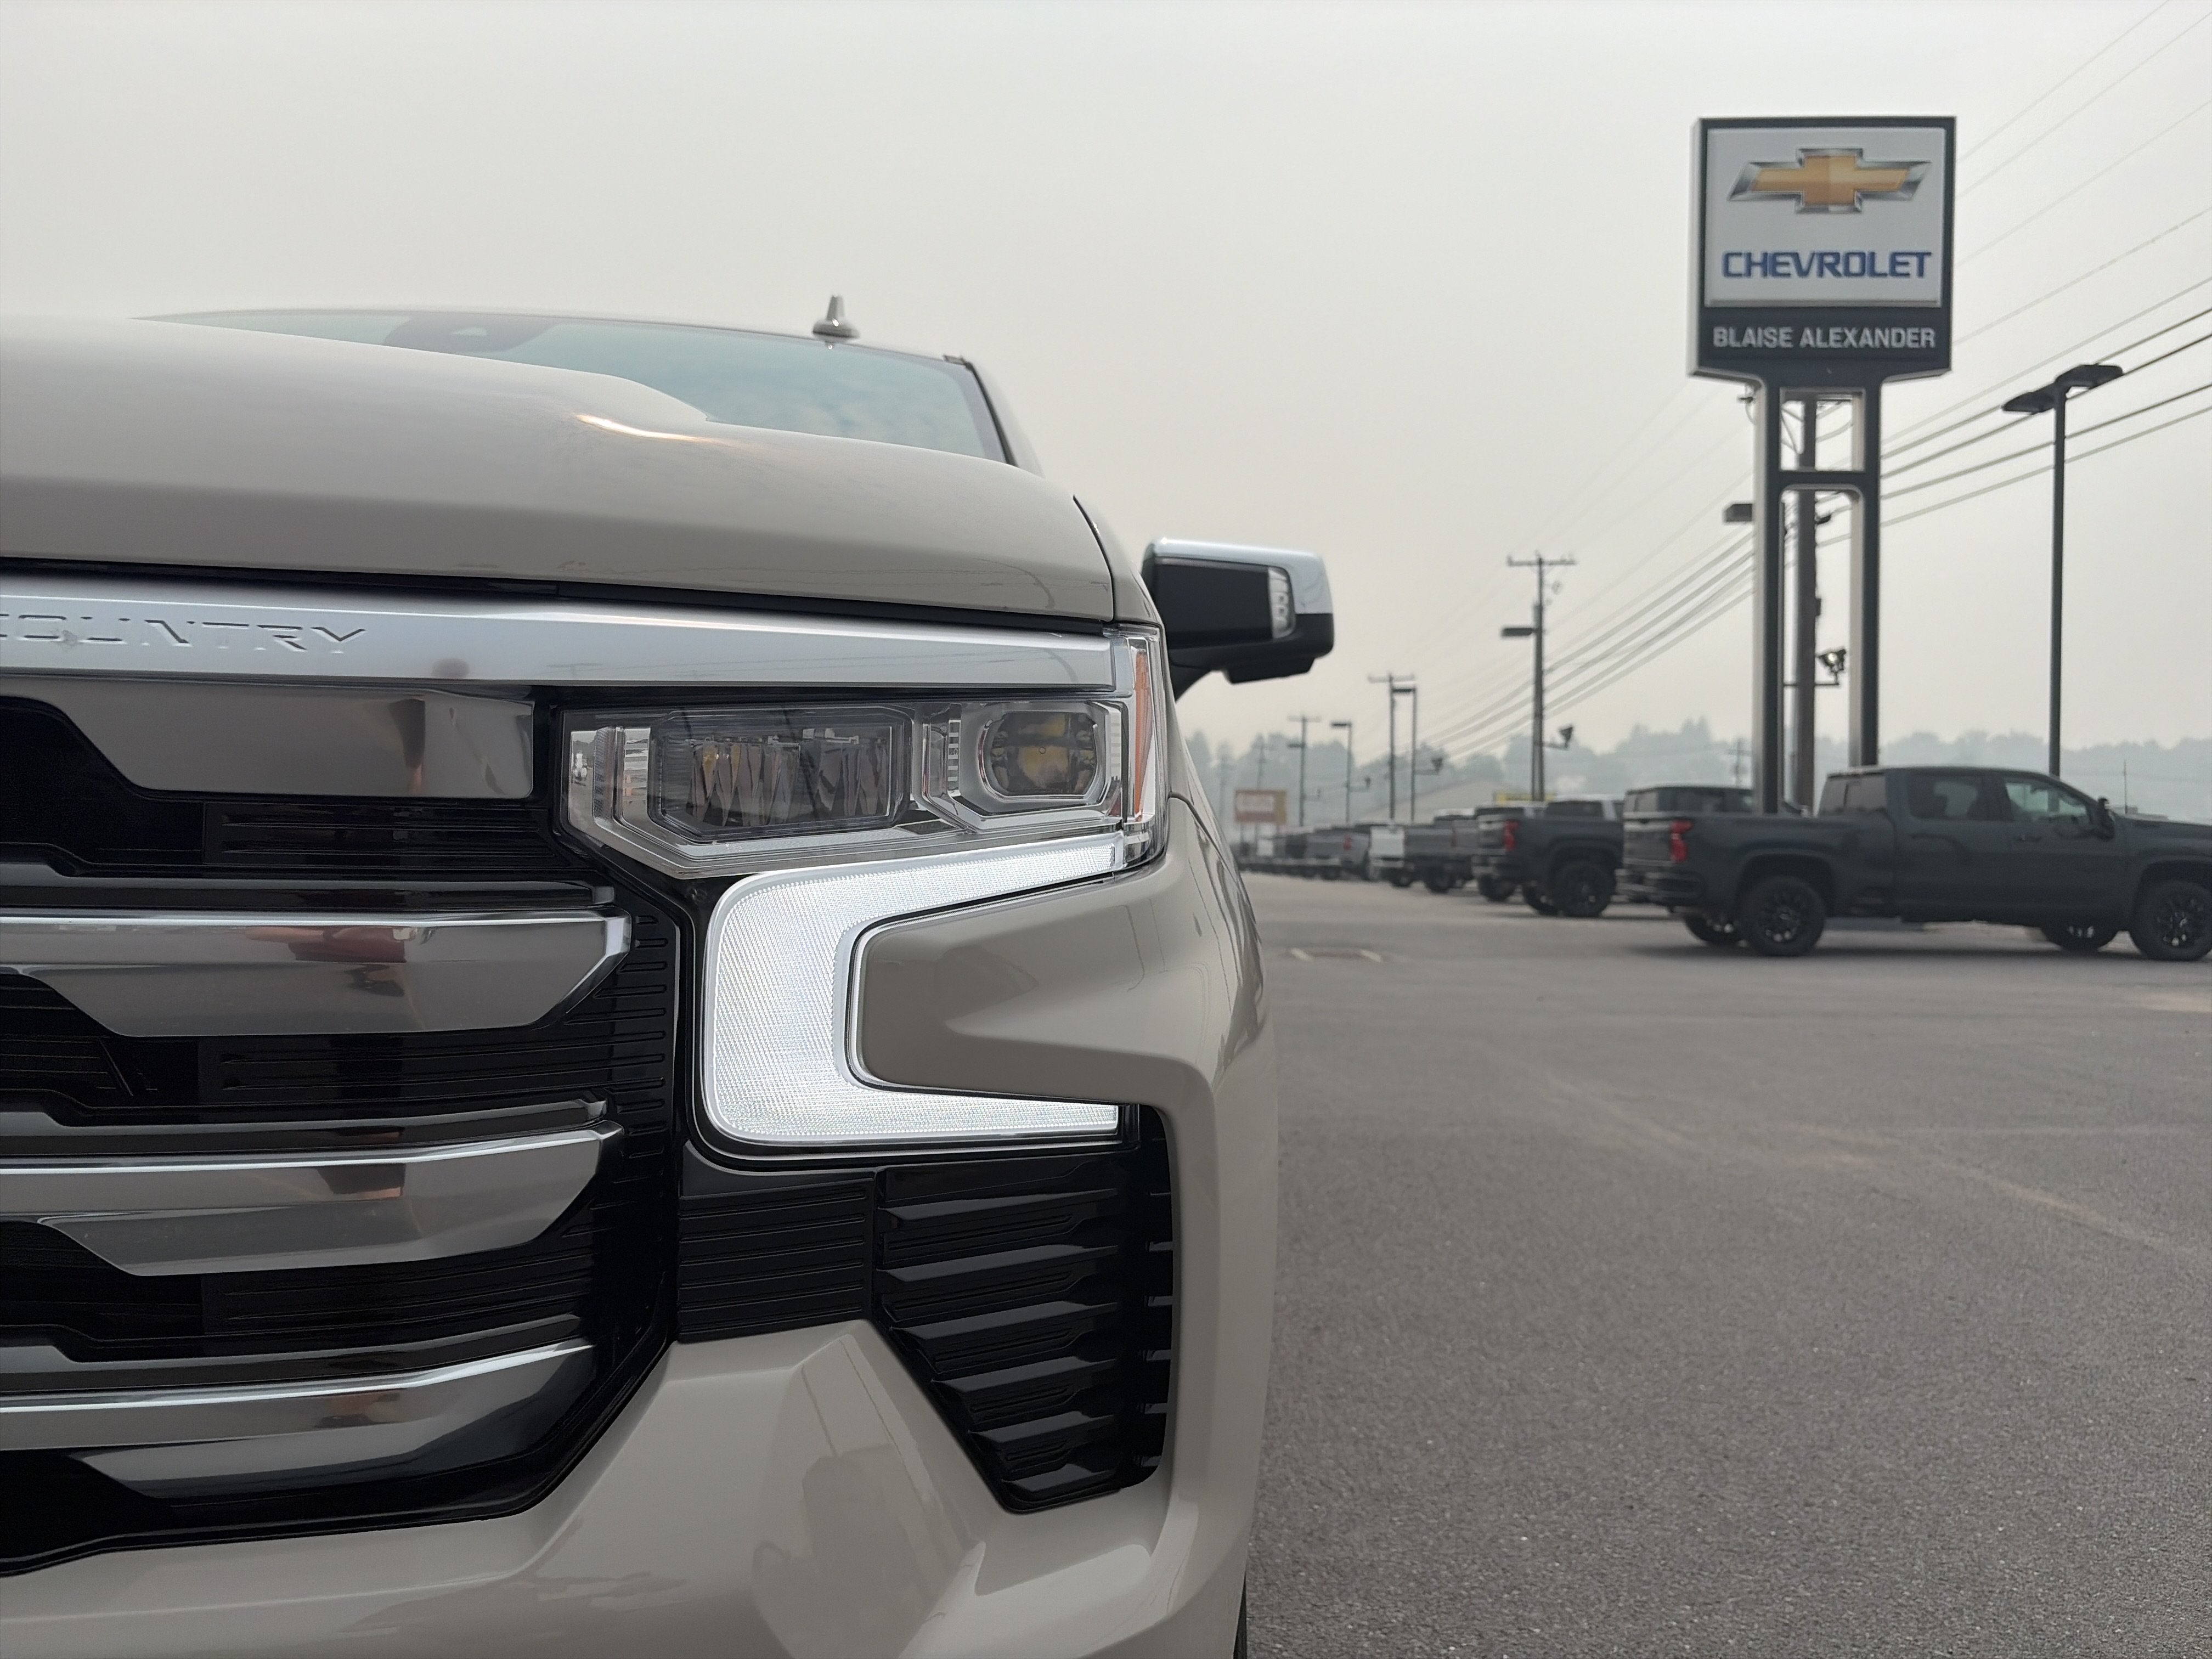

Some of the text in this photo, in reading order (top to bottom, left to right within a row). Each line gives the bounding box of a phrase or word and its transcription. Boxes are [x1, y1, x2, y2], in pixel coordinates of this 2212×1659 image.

[1723, 251, 1932, 278] CHEVROLET
[1713, 326, 1936, 348] BLAISE ALEXANDER
[0, 613, 366, 653] OUNTRY
